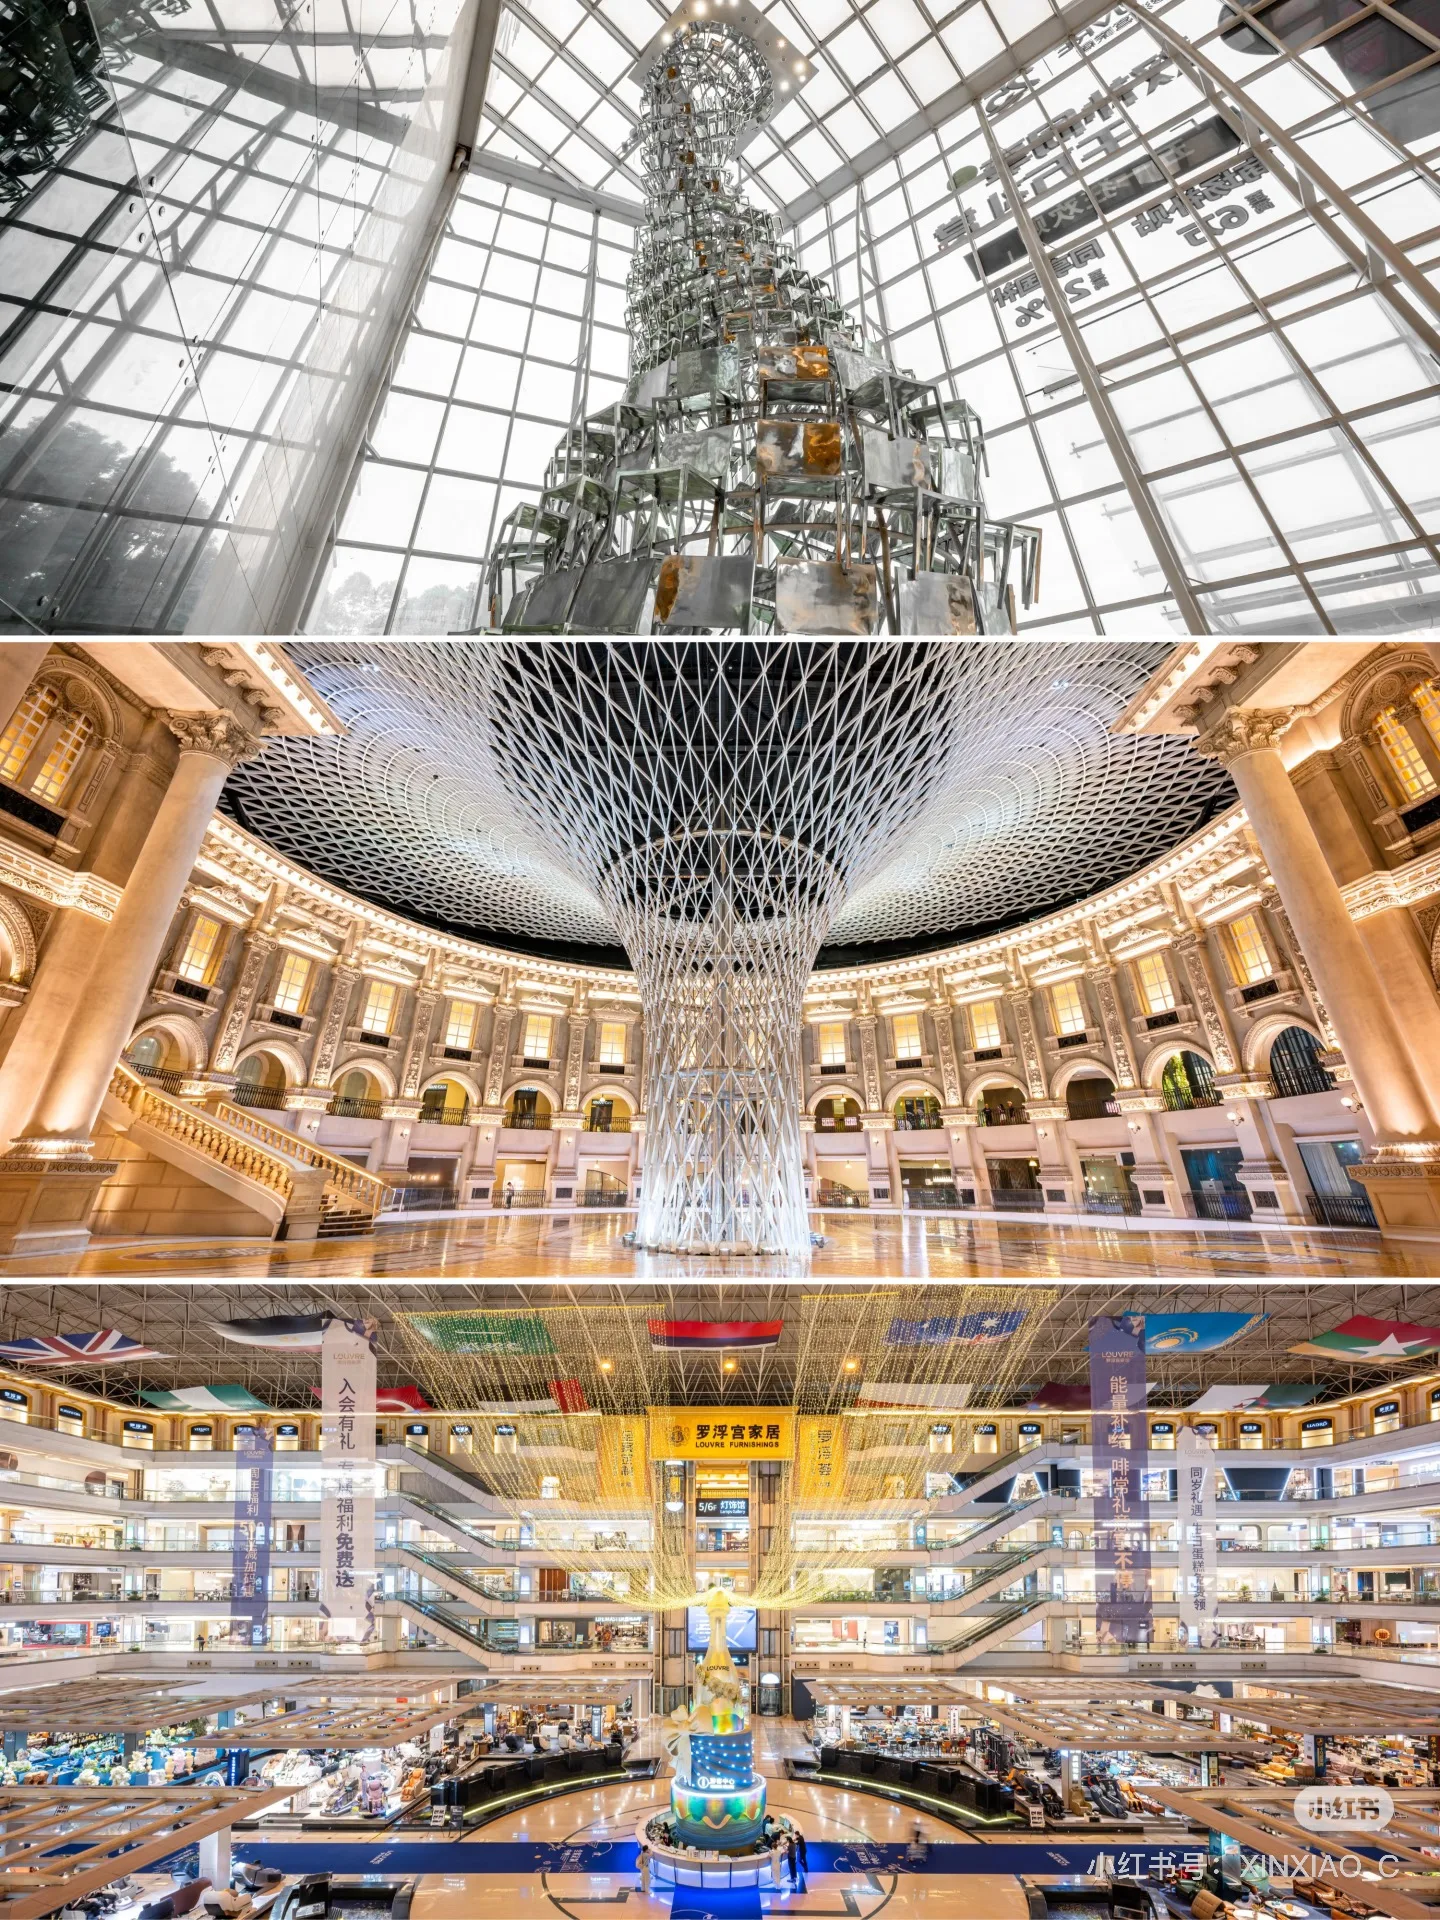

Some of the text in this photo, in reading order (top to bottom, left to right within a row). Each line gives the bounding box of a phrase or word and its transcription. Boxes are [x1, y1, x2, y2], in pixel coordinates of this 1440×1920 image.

[333, 1352, 365, 1360] LOUVRE
[338, 1377, 356, 1450] 入会有礼
[1110, 1375, 1128, 1450] 能量补给
[696, 1424, 781, 1440] 罗浮宫家居
[1190, 1467, 1203, 1517] 同岁礼遇
[698, 1502, 718, 1513] 5/6F
[720, 1500, 746, 1510] 灯饰馆
